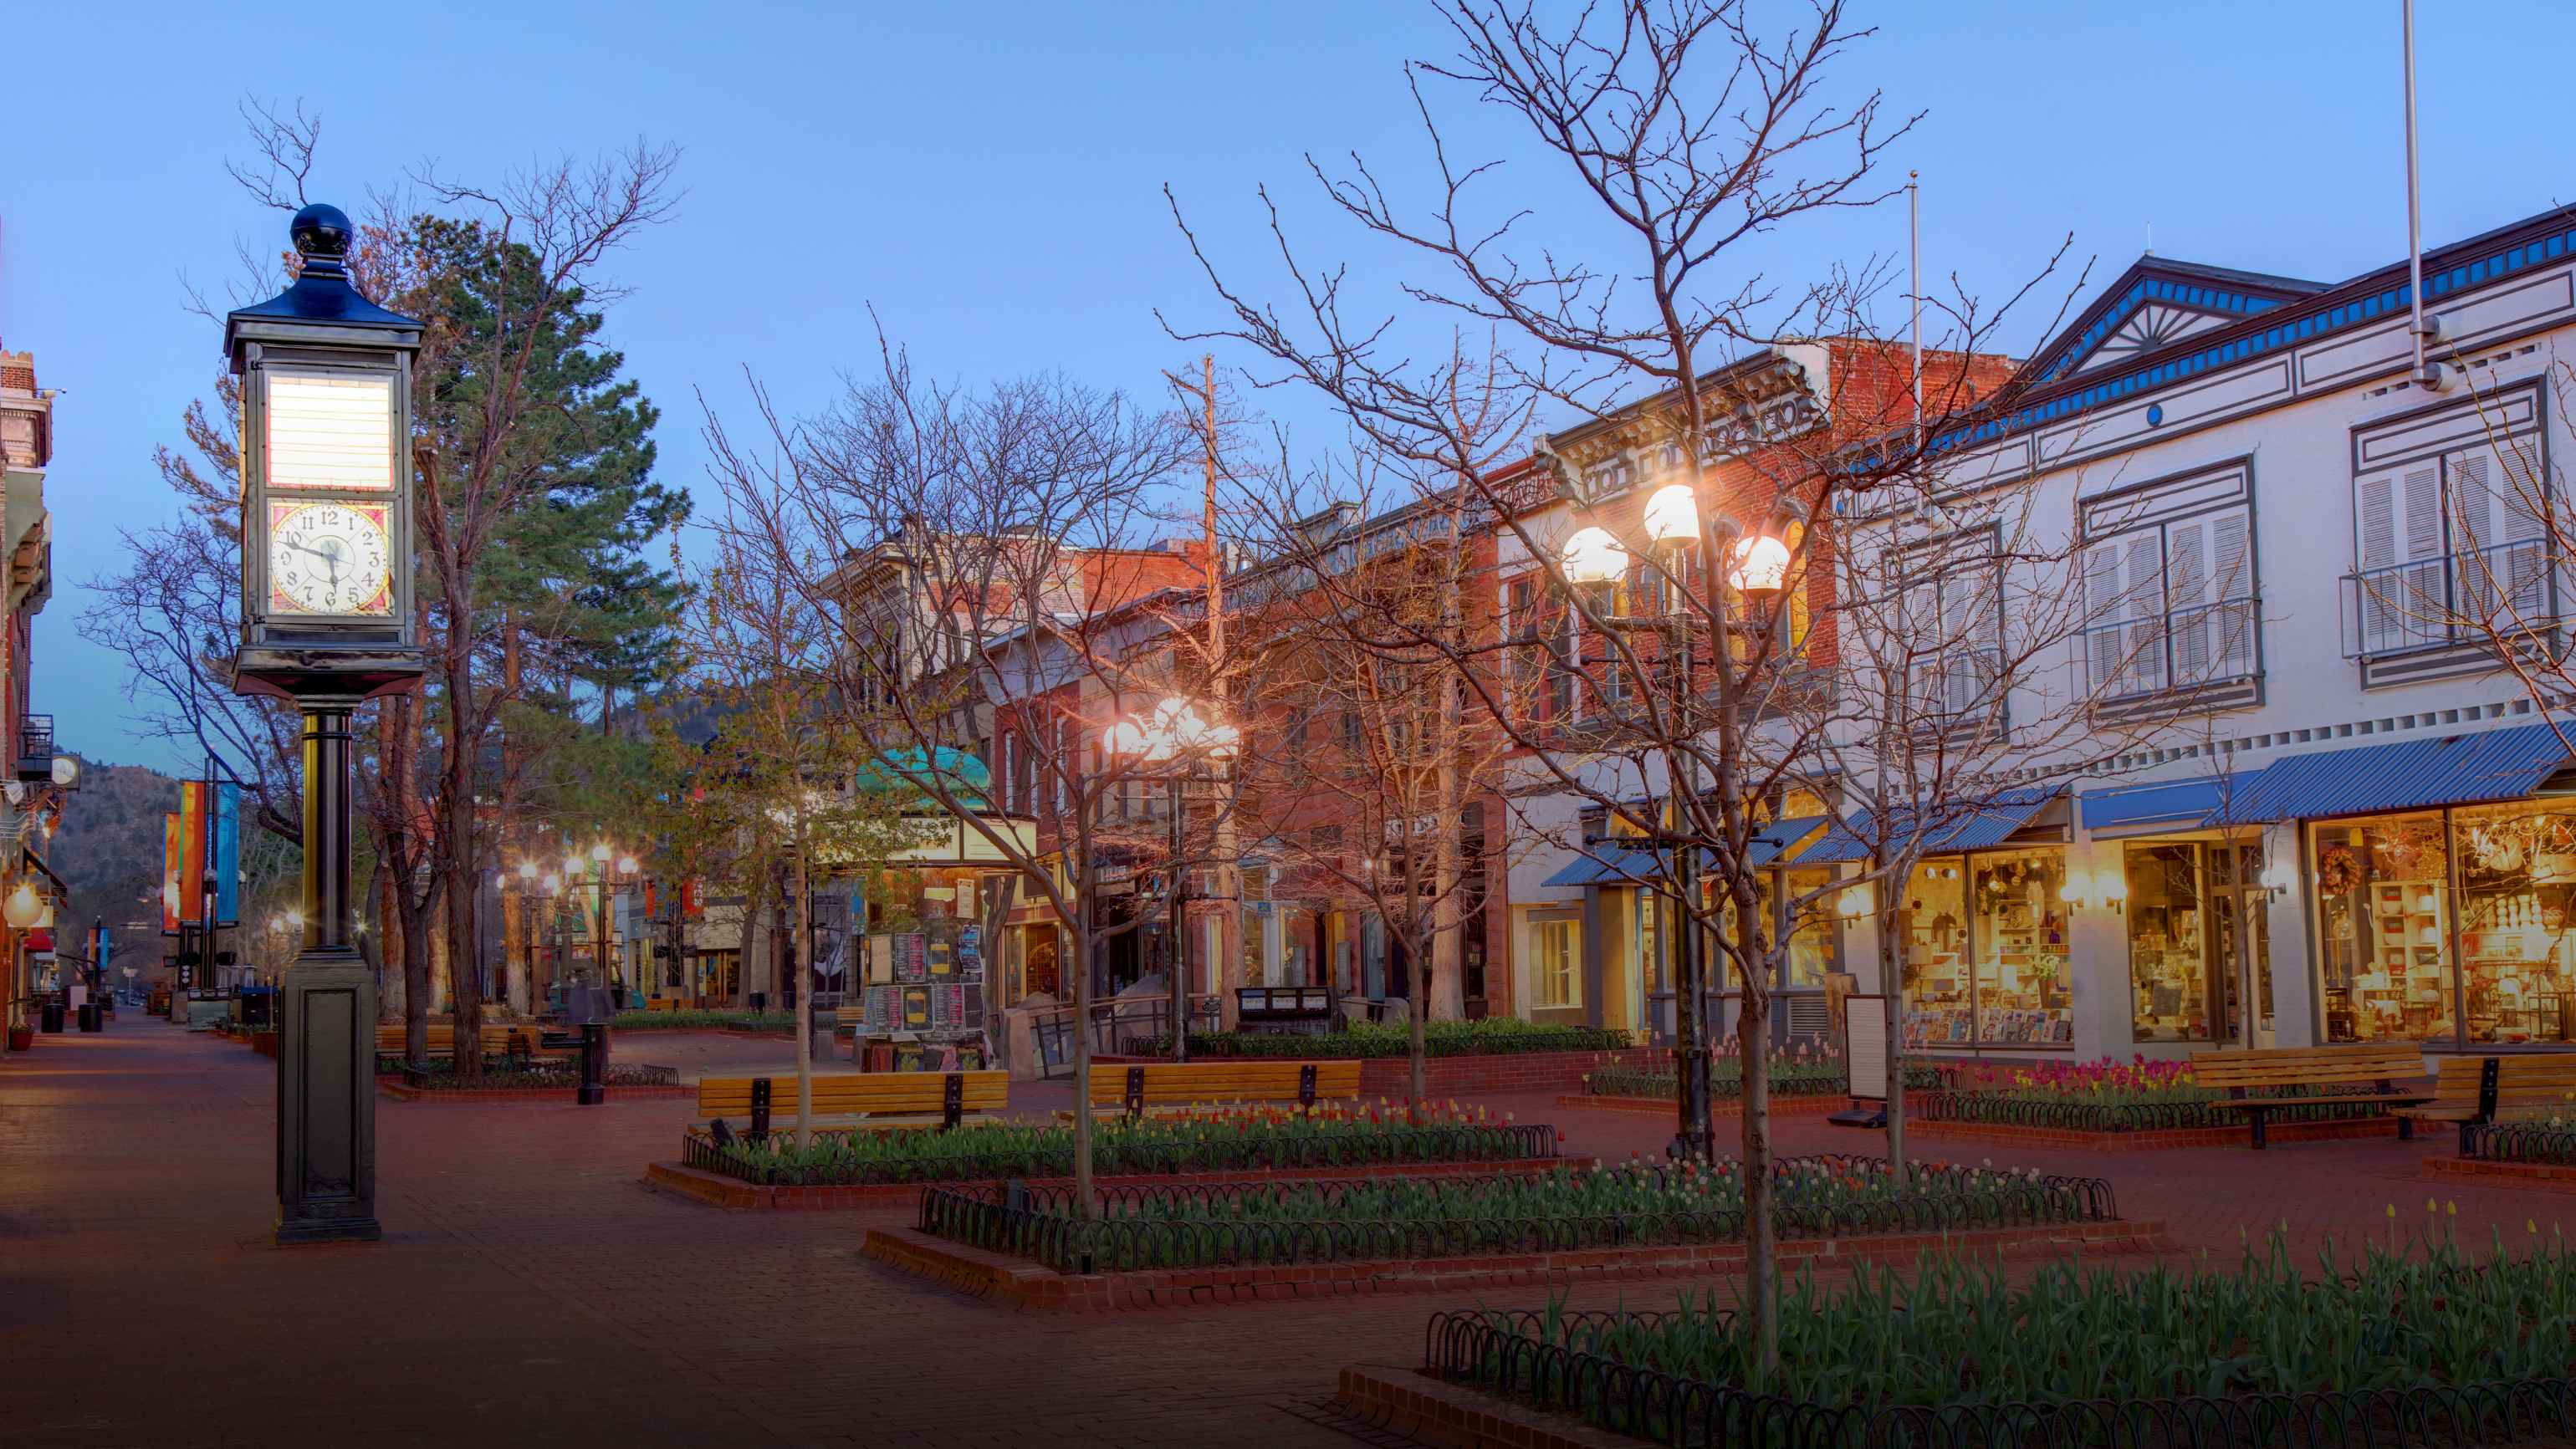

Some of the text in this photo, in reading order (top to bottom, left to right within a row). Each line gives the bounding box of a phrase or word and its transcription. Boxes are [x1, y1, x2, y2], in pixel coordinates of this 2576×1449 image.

[302, 516, 314, 530] 11
[321, 510, 339, 525] 12
[349, 517, 355, 530] 1
[286, 531, 302, 543] 10
[361, 531, 373, 545] 2
[280, 550, 292, 566] 9
[369, 551, 380, 568] 3
[287, 571, 298, 586] 8
[361, 572, 375, 587] 4
[304, 586, 314, 602] 7
[325, 591, 336, 607] 6
[347, 587, 360, 603] 5
